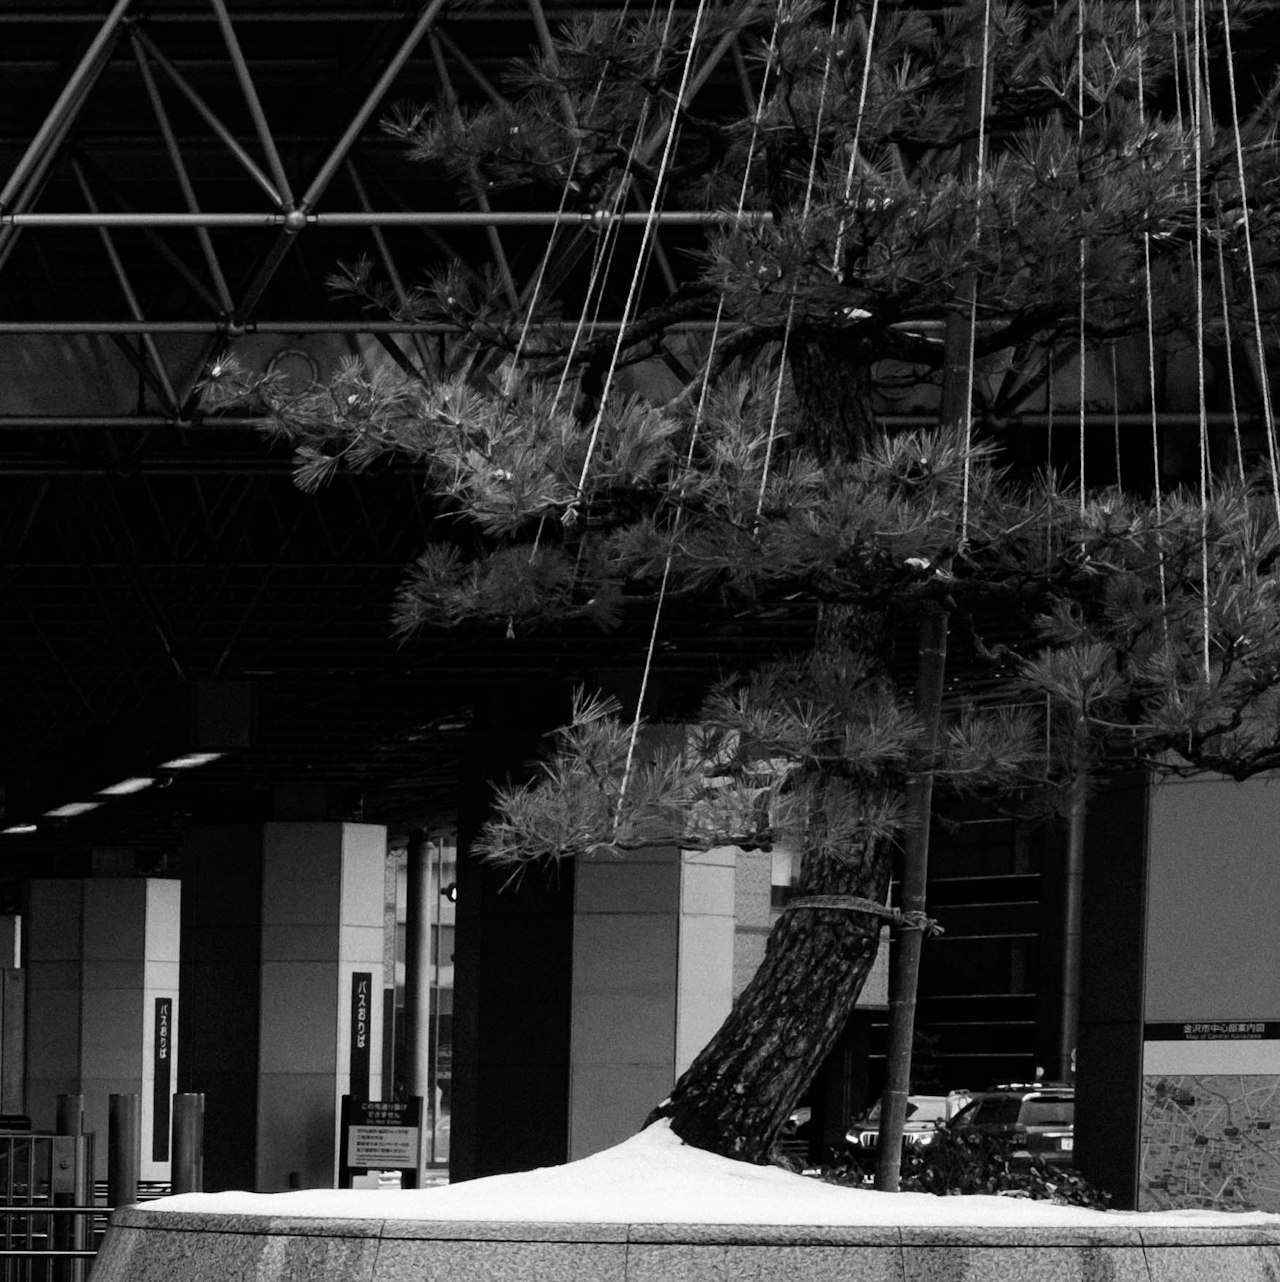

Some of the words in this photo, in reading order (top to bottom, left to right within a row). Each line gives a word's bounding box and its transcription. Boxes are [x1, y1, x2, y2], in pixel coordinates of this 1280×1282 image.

[159, 1004, 168, 1059] バスおりば
[357, 980, 367, 1048] バスおりば
